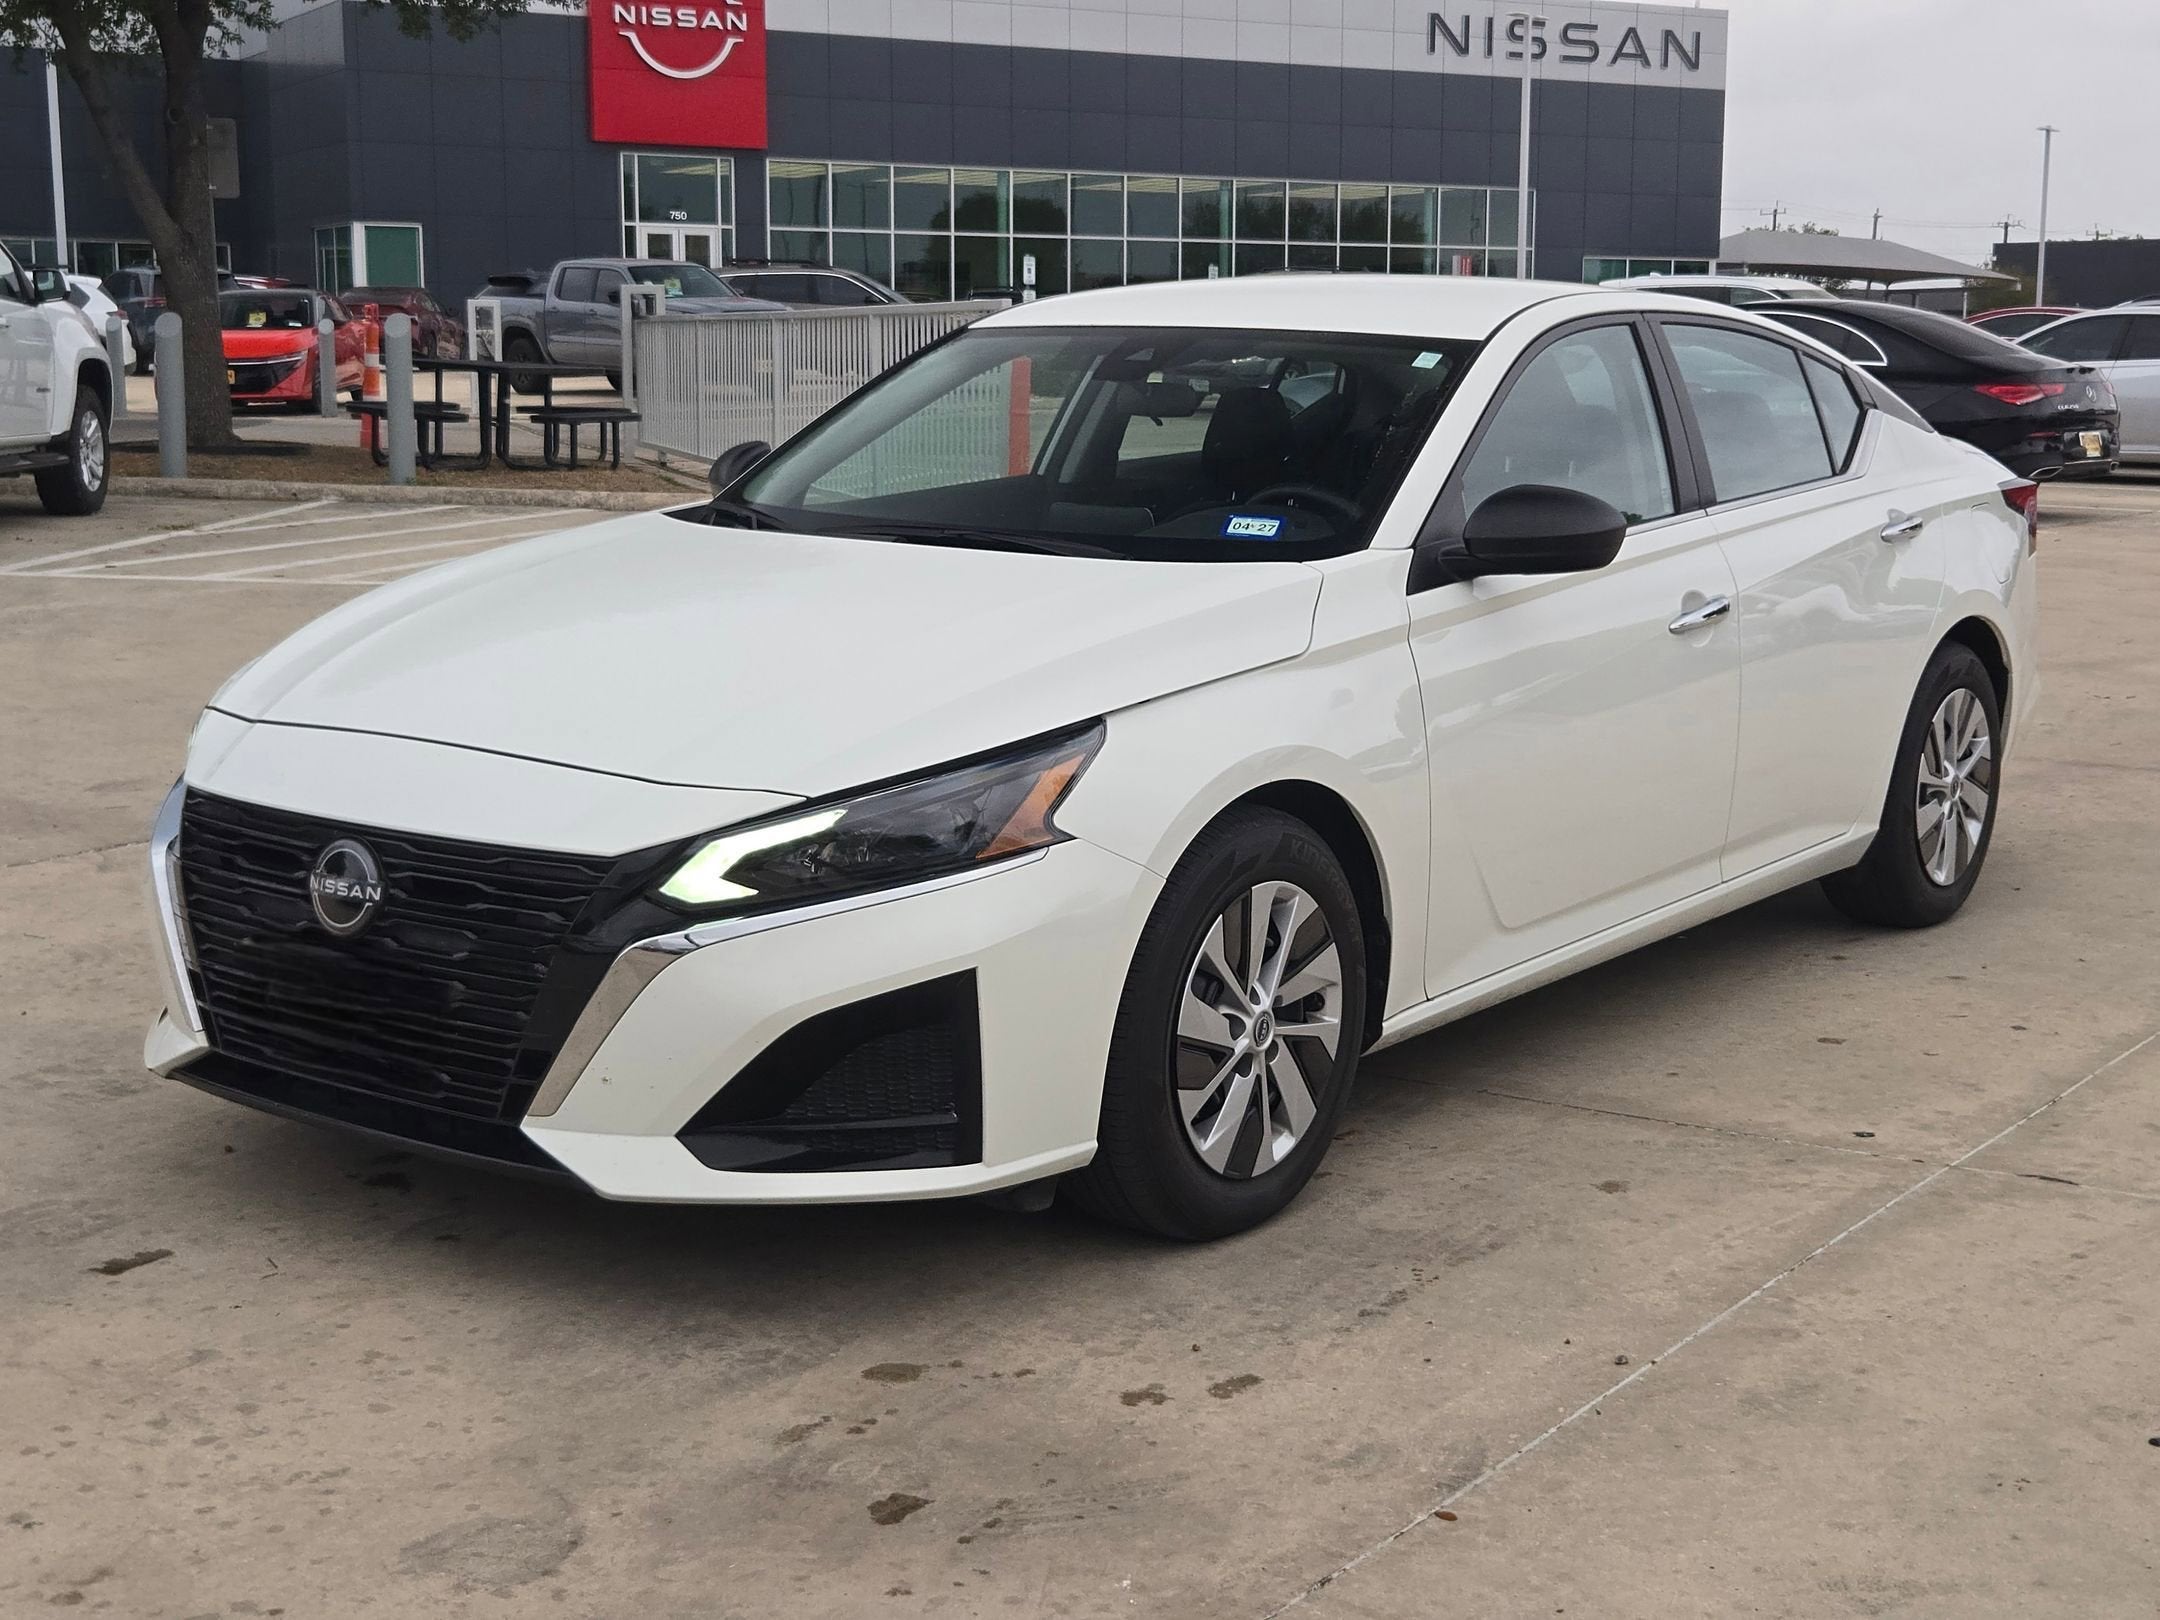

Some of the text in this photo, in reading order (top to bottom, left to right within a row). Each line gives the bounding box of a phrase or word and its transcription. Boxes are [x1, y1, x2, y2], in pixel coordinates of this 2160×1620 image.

[614, 4, 747, 31] NISSAN
[1427, 12, 1701, 72] NISSAN
[669, 210, 688, 221] 750
[1232, 521, 1277, 533] 04 27
[309, 873, 382, 901] NISSAN
